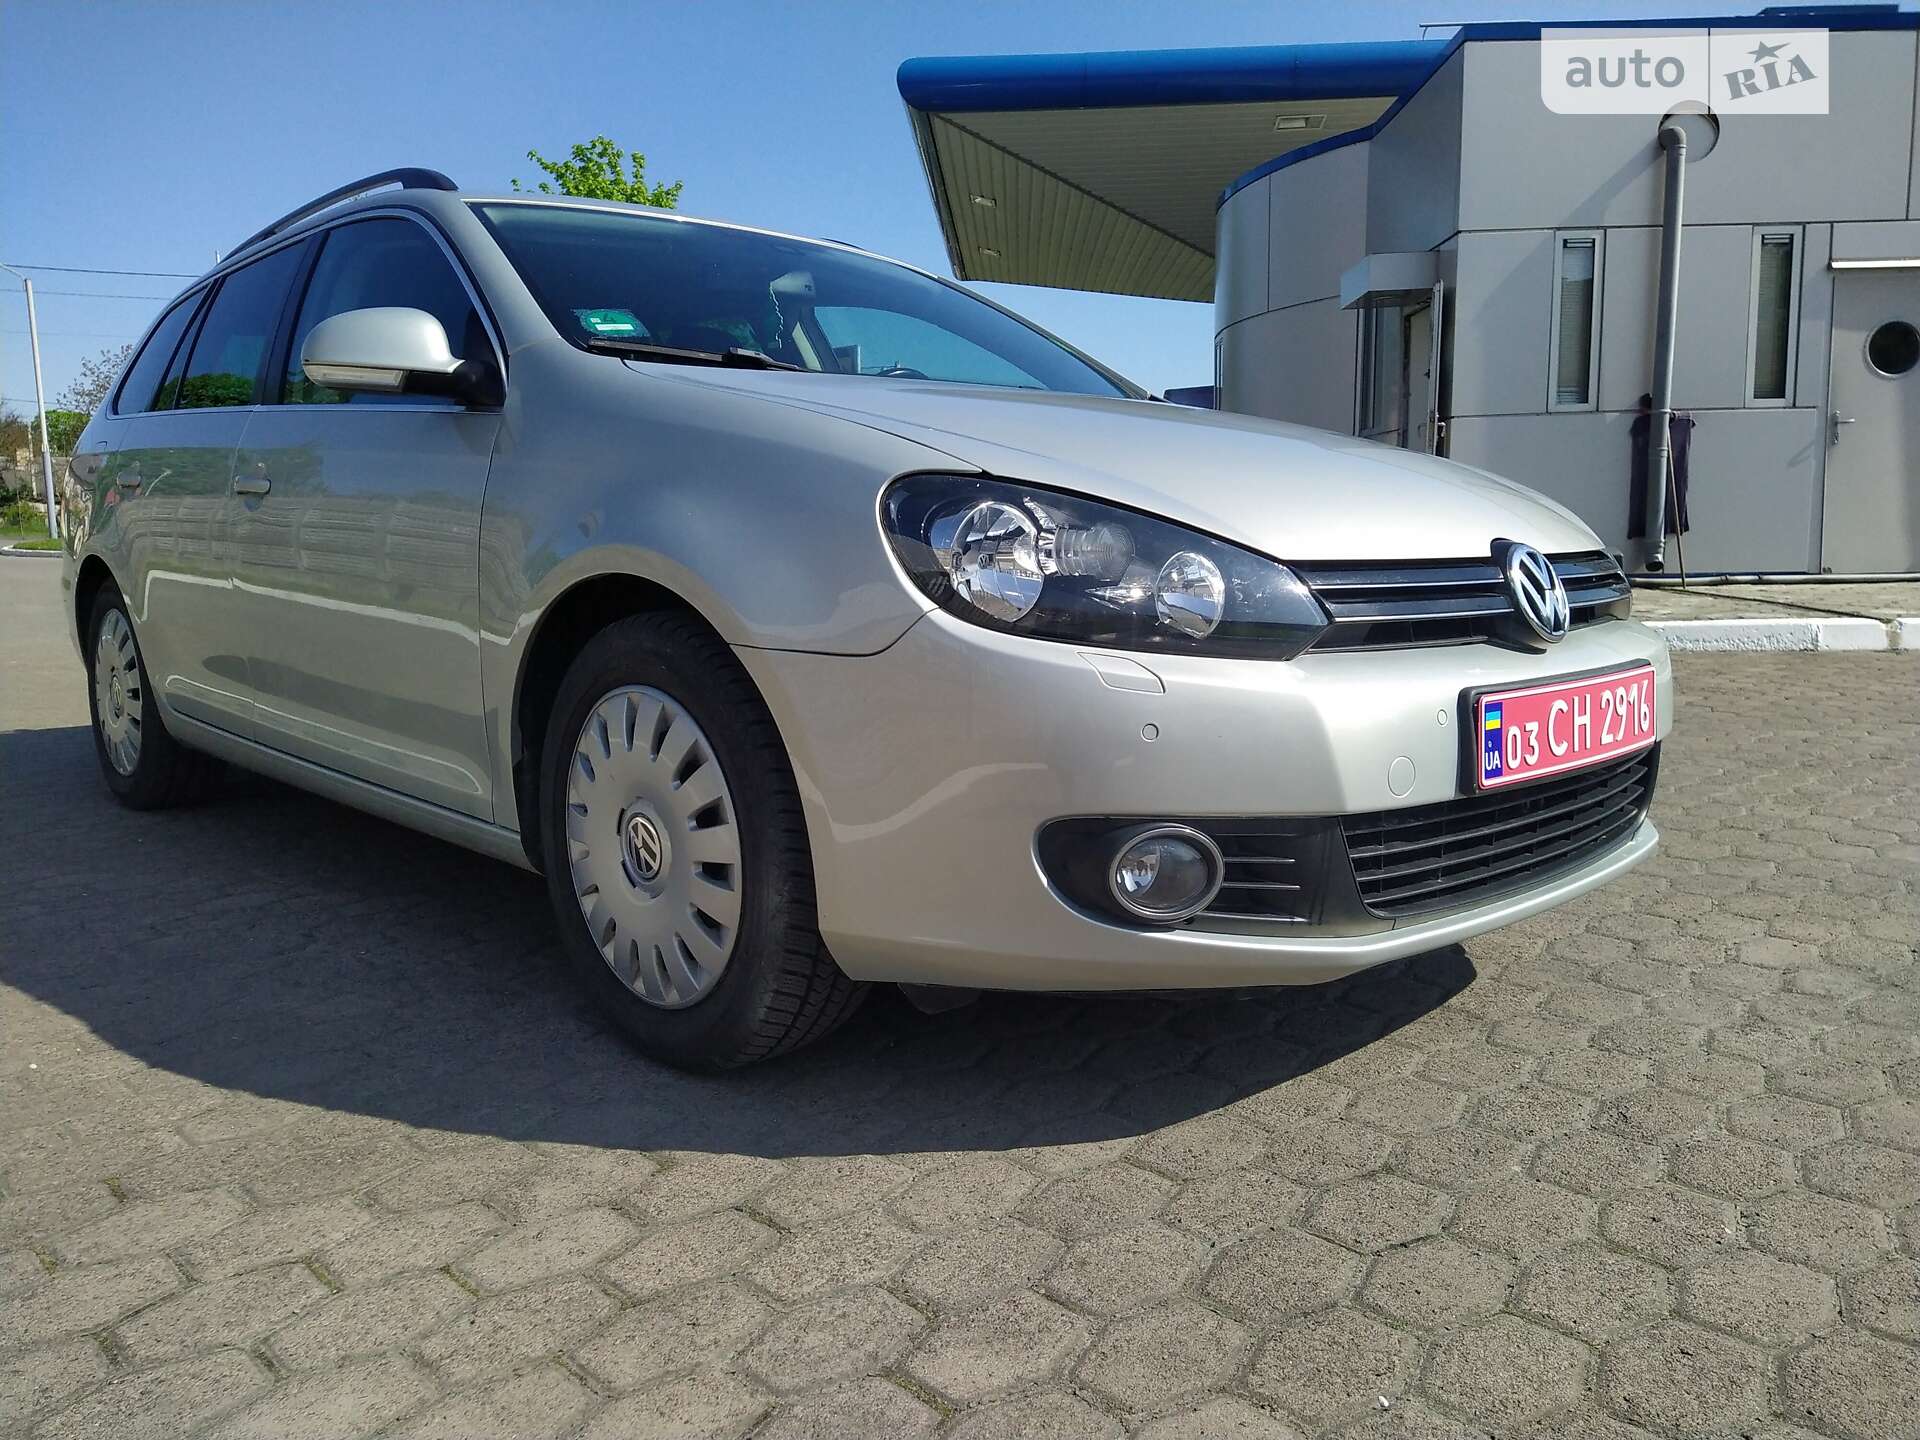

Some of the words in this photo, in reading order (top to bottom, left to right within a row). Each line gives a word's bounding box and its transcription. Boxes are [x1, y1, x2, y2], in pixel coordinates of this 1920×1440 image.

[1506, 721, 1540, 770] 03
[1548, 694, 1591, 756] CH
[1601, 680, 1650, 745] 2916
[1485, 750, 1501, 771] UA
